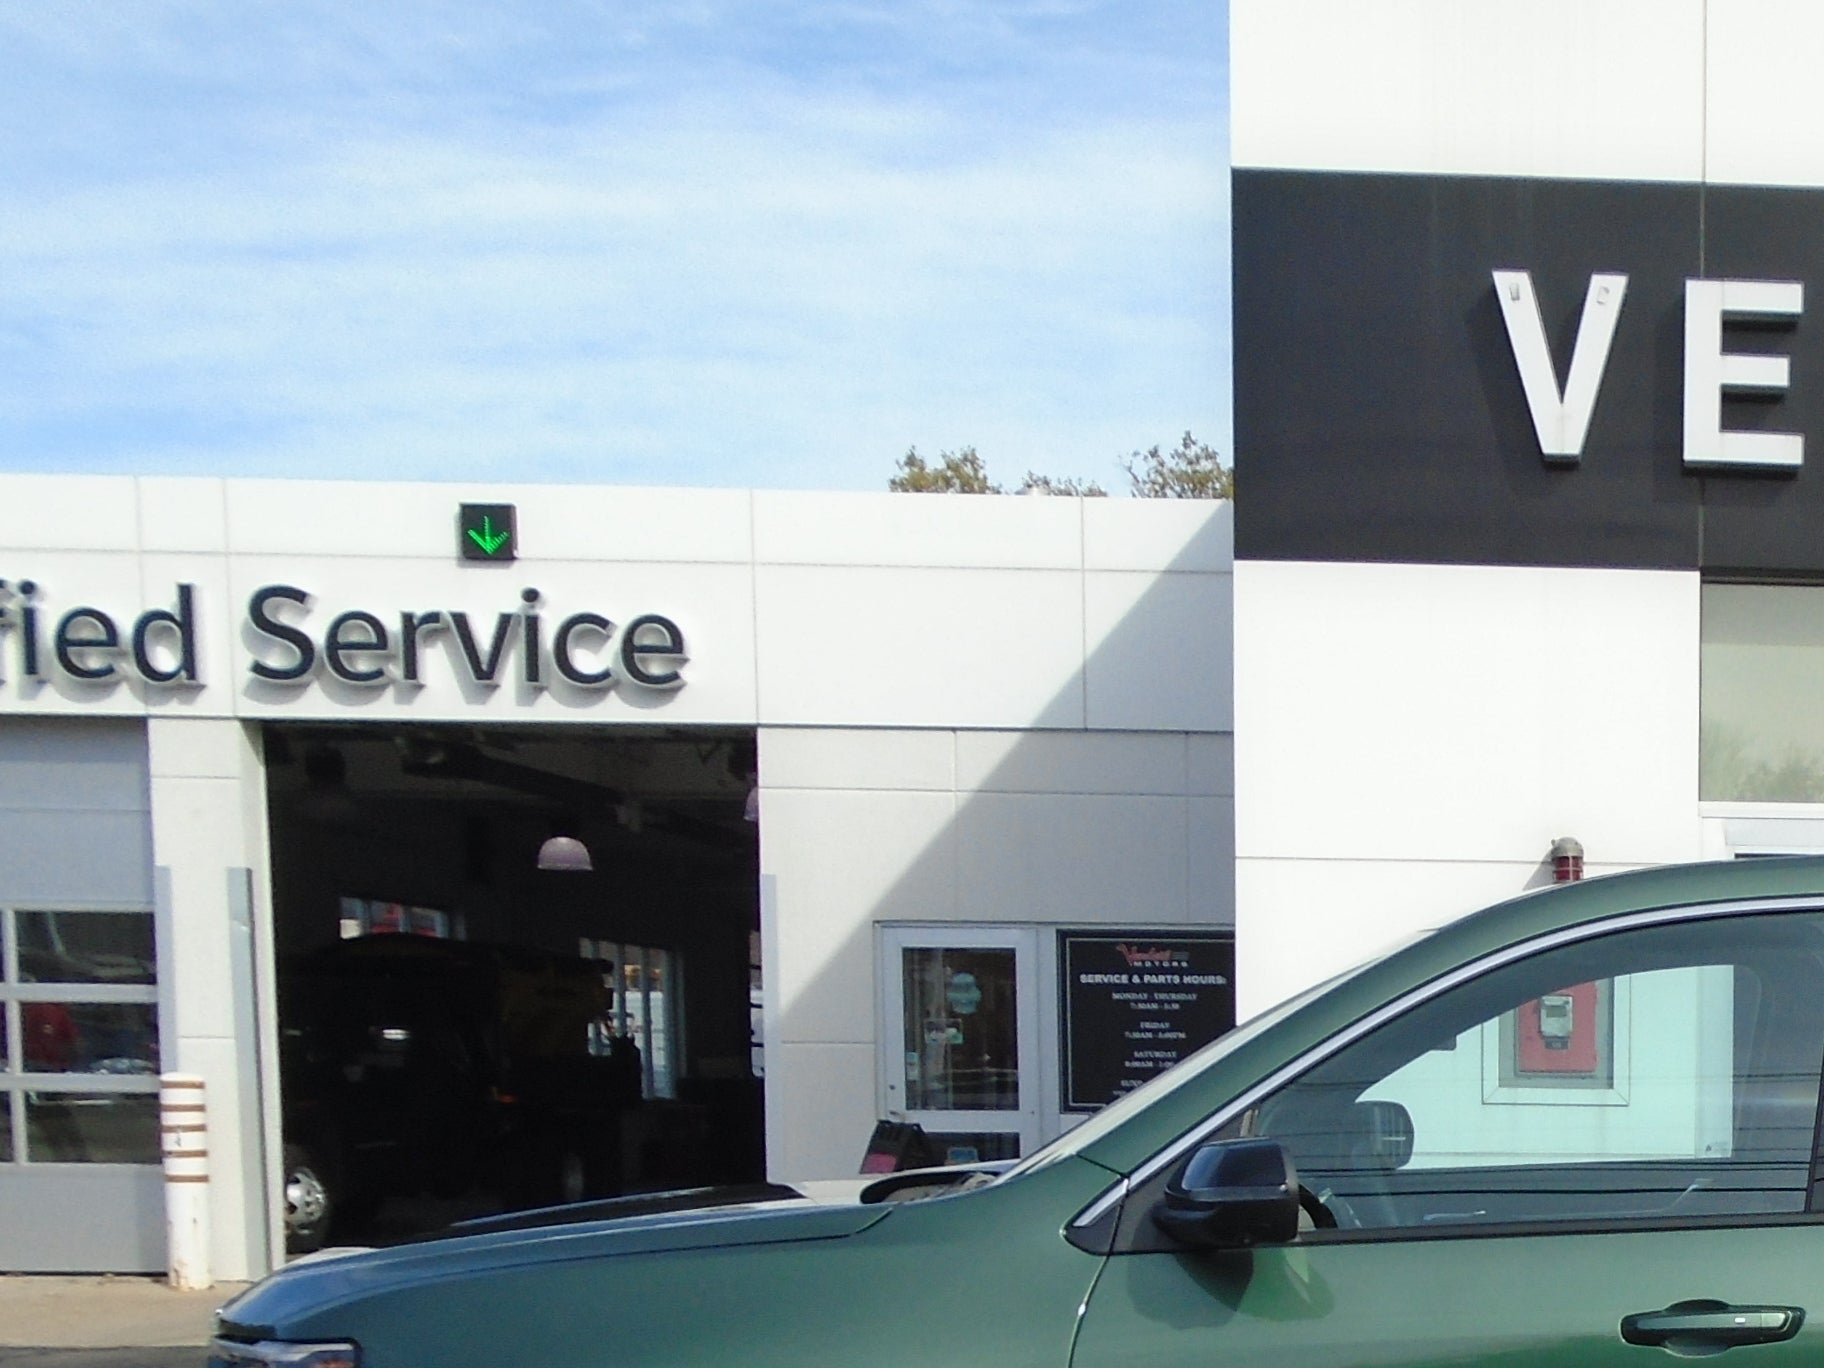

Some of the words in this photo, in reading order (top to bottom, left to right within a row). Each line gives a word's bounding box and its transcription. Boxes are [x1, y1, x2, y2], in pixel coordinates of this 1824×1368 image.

[0, 579, 198, 682] ied
[247, 584, 687, 686] Service
[1080, 974, 1128, 984] SERVICE
[1131, 974, 1141, 984] &
[1144, 974, 1180, 985] PARTS
[1112, 992, 1148, 1000] MONDAY
[1153, 992, 1197, 1001] THURSDAY
[1140, 1021, 1170, 1029] FRIDAY
